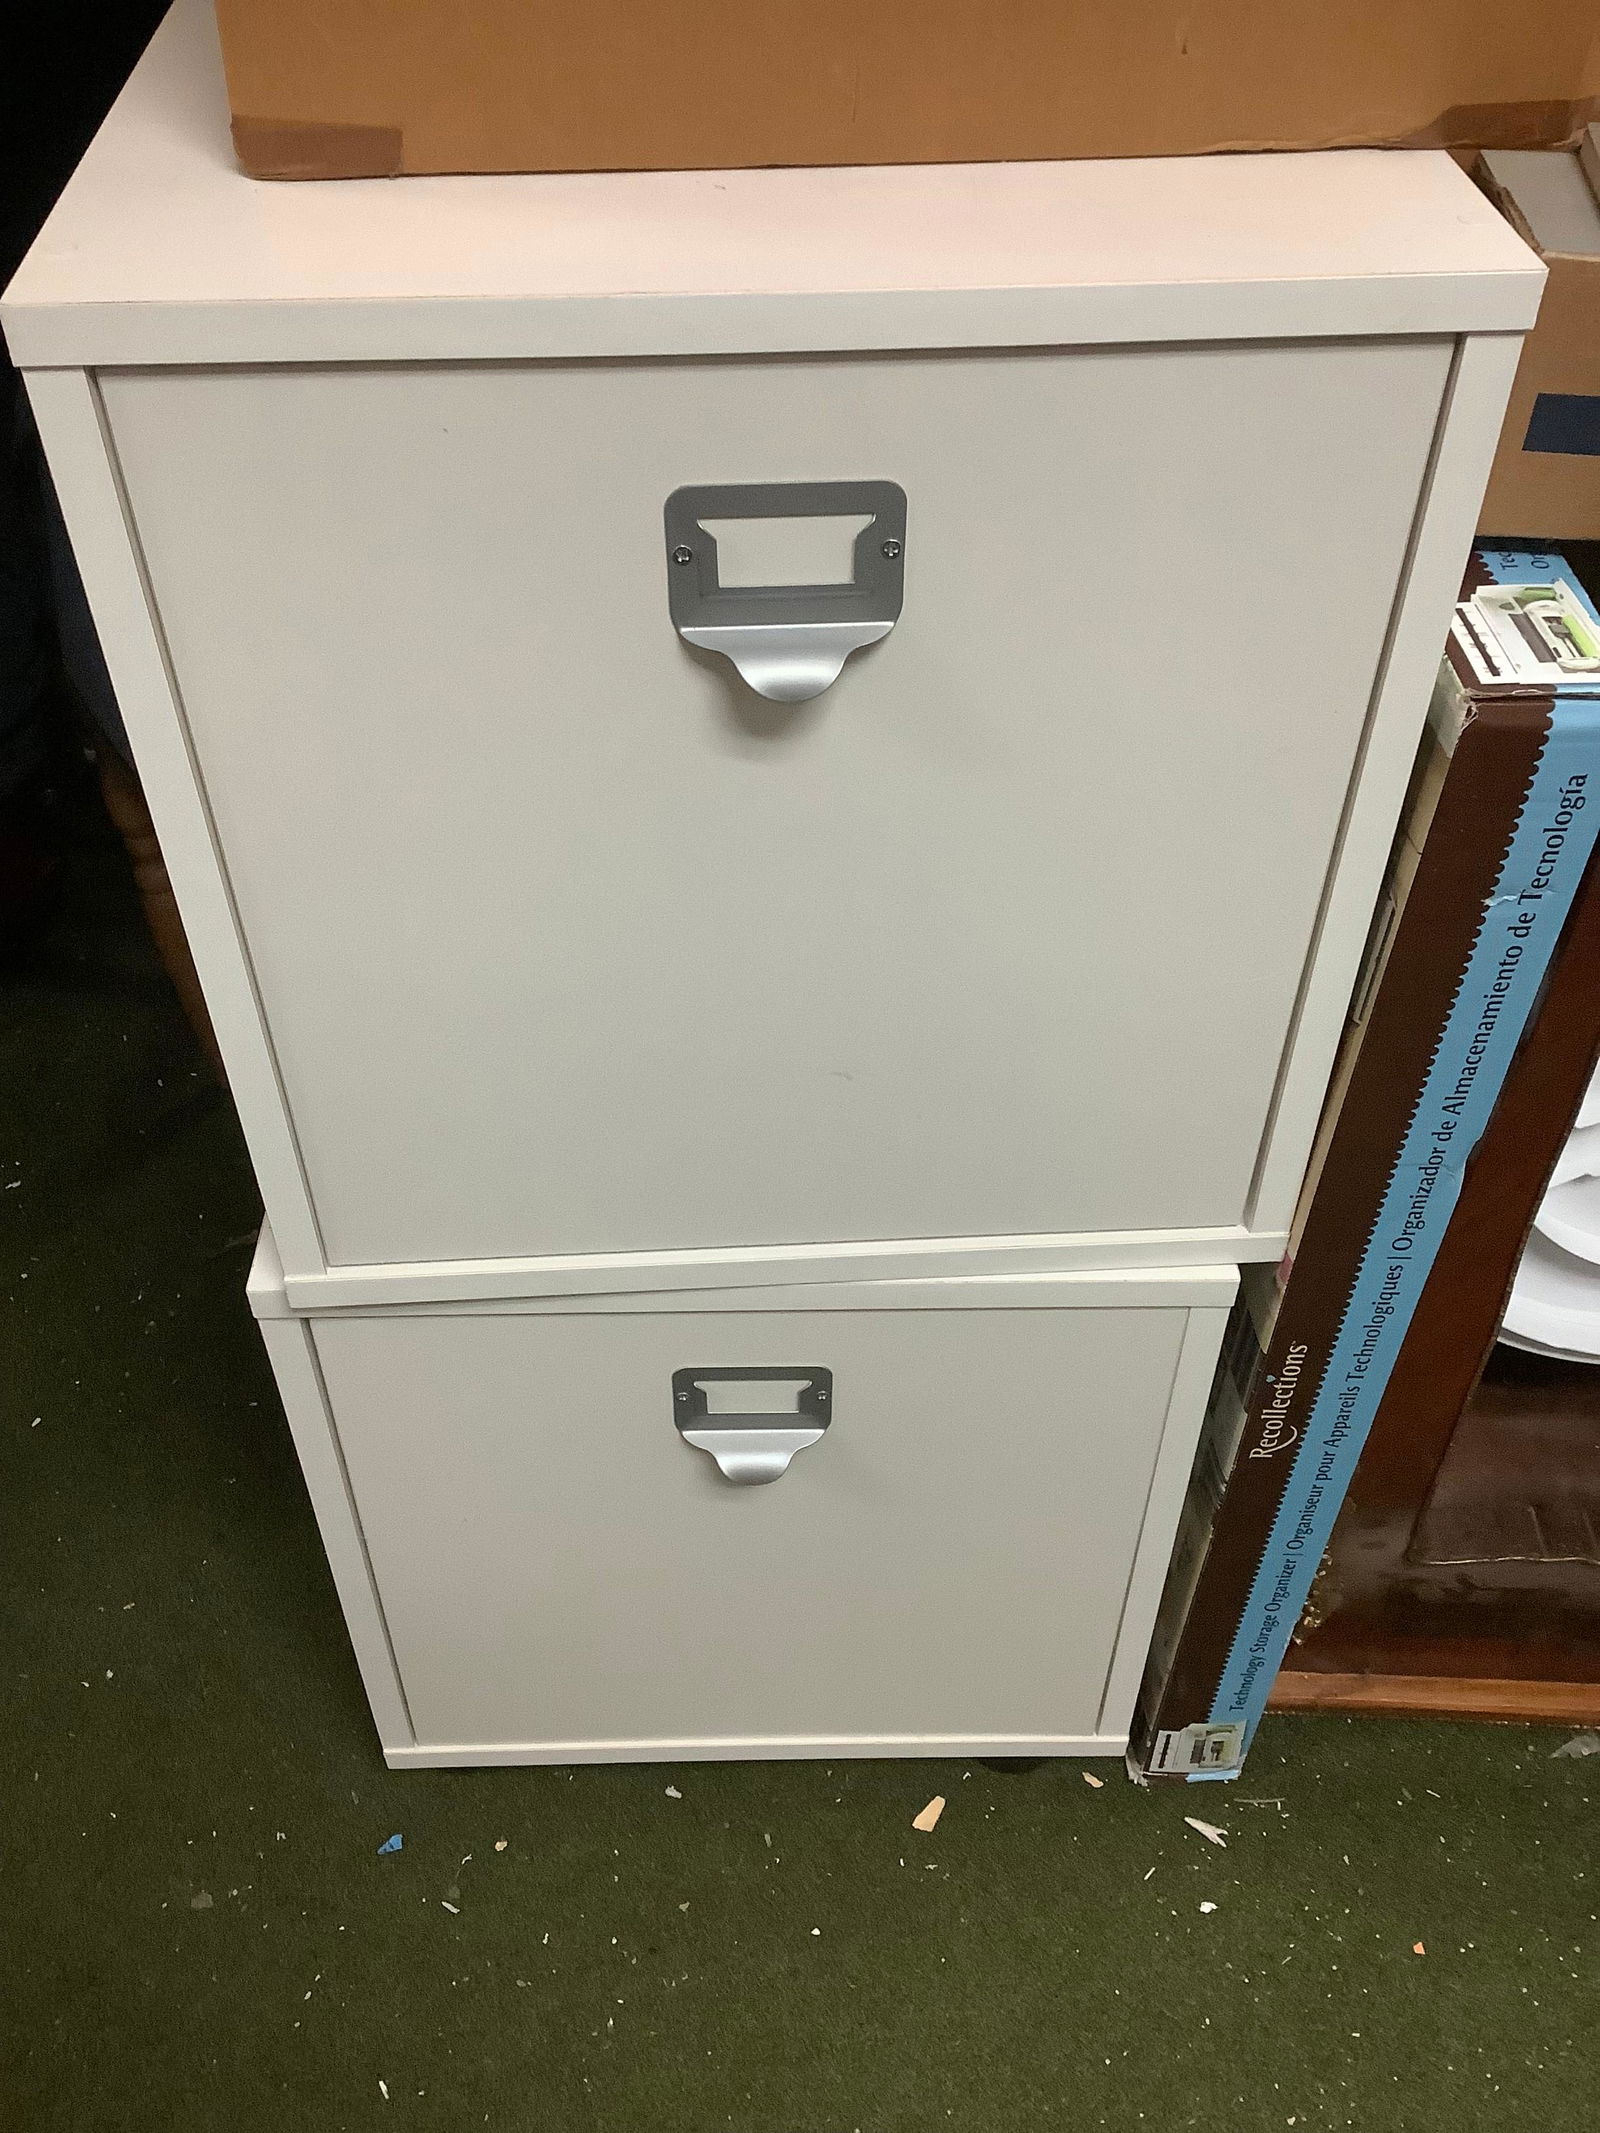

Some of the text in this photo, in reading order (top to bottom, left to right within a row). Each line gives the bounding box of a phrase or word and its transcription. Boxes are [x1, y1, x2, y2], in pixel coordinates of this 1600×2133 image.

[1518, 774, 1588, 906] Tecnología
[1507, 913, 1537, 939] de
[1442, 946, 1523, 1116] Almacenamiento
[1432, 1121, 1458, 1142] de
[1392, 1147, 1447, 1252] Organizador
[1345, 1265, 1404, 1382] Technologiques
[1249, 1342, 1308, 1459] Recollections
[1323, 1387, 1361, 1448] Appareils
[1315, 1451, 1336, 1481] pour
[1286, 1485, 1324, 1550] Organiseur
[1264, 1559, 1297, 1612] Organizer
[1249, 1614, 1280, 1653] Storage
[1229, 1656, 1266, 1711] Technology
